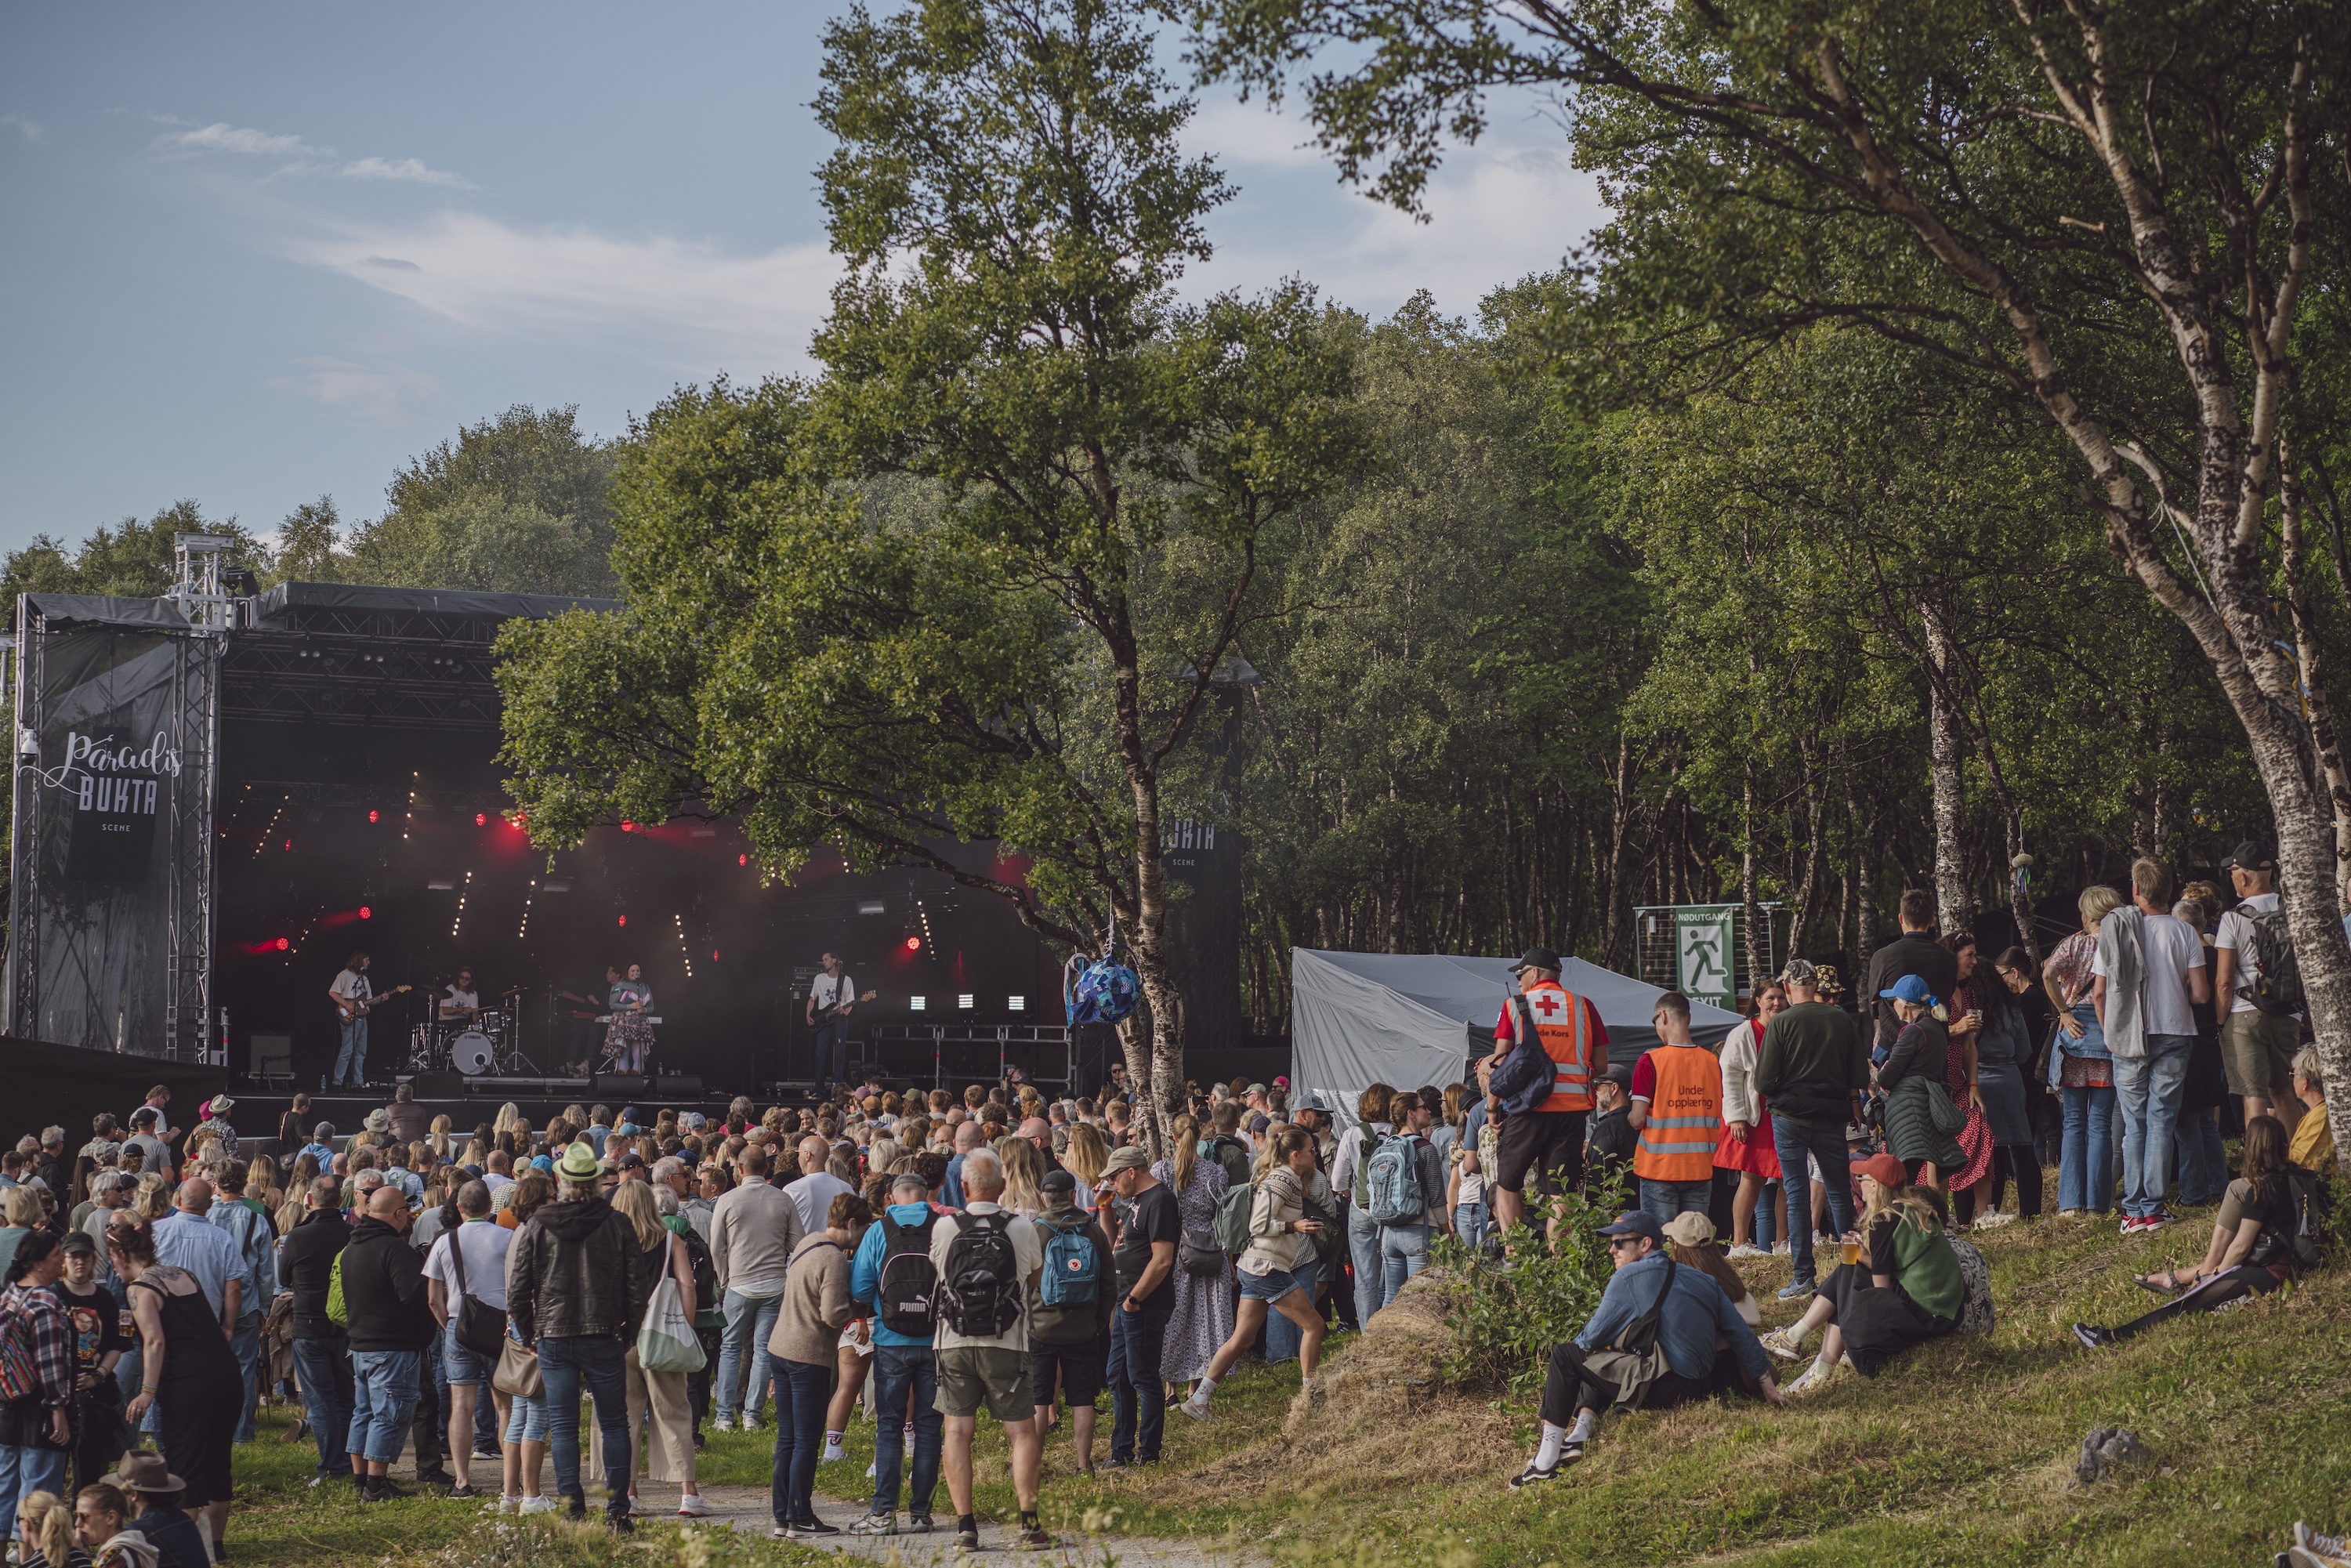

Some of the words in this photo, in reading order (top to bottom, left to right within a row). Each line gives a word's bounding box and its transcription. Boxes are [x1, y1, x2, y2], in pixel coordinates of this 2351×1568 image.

[45, 731, 183, 786] Paradis
[79, 776, 158, 815] BUKTA
[102, 824, 131, 832] SCENE
[1160, 818, 1215, 849] UKTA
[1678, 912, 1730, 922] NØDUTGANG
[1692, 996, 1722, 1009] XIT
[1679, 1085, 1704, 1095] Under
[1668, 1097, 1712, 1110] opplæring
[900, 1302, 926, 1312] PUMA
